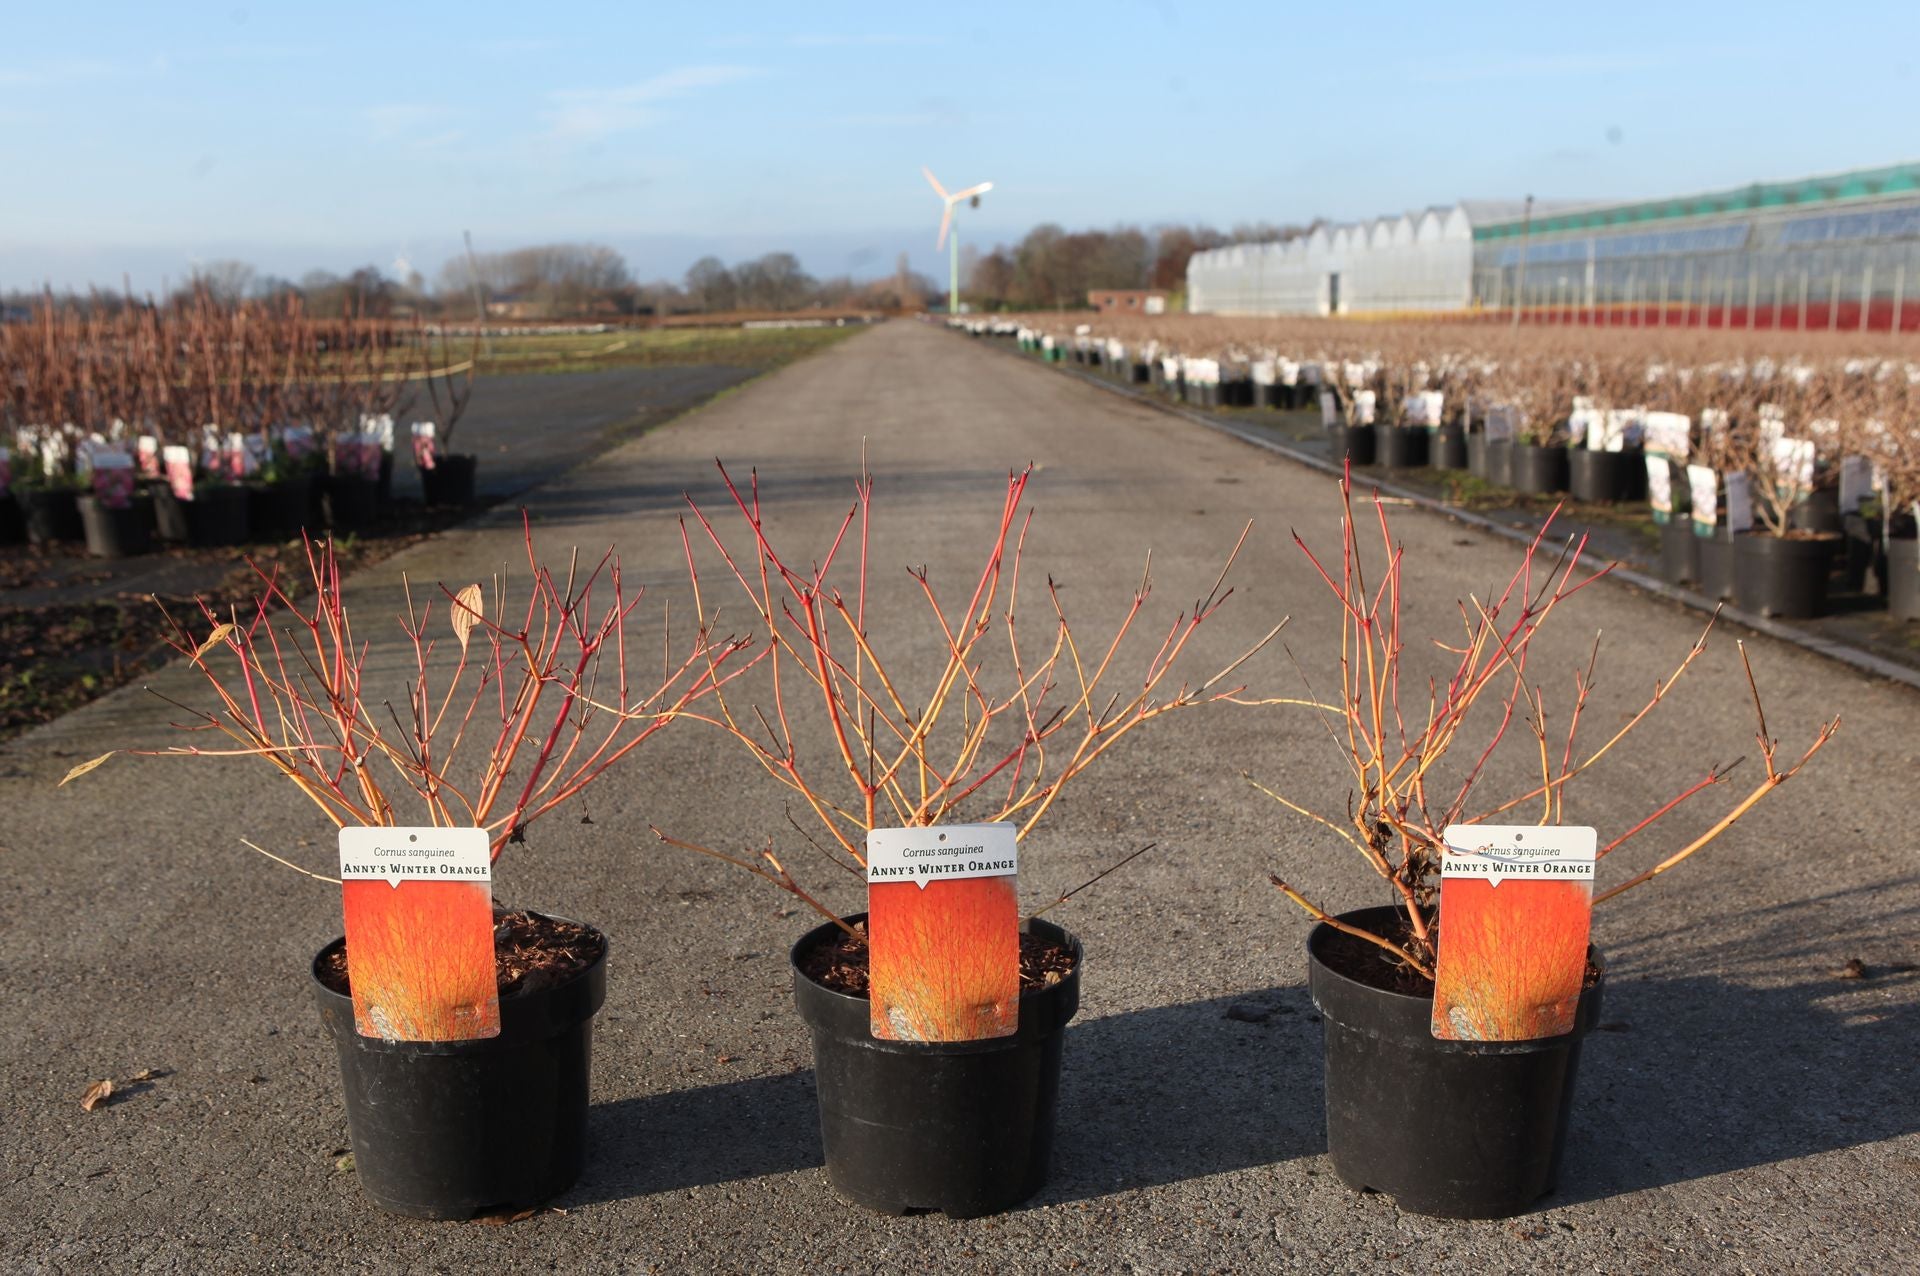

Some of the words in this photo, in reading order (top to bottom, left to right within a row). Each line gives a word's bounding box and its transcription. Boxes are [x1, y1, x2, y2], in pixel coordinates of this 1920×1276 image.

[373, 847, 407, 857] Cornus
[408, 847, 455, 860] sanguinea
[902, 847, 936, 858] Cornus
[937, 844, 984, 858] sanguinea
[1513, 846, 1561, 858] sanguinea
[343, 863, 386, 873] ANNY'S
[390, 864, 436, 874] WINTER
[440, 864, 487, 875] ORANGE
[871, 866, 914, 876] ANNY'S
[918, 864, 965, 874] WINTER
[968, 860, 1015, 871] ORANGE
[1444, 861, 1488, 872] ANNY'S
[1492, 862, 1539, 873] WINTER
[1543, 863, 1591, 874] ORANGE
